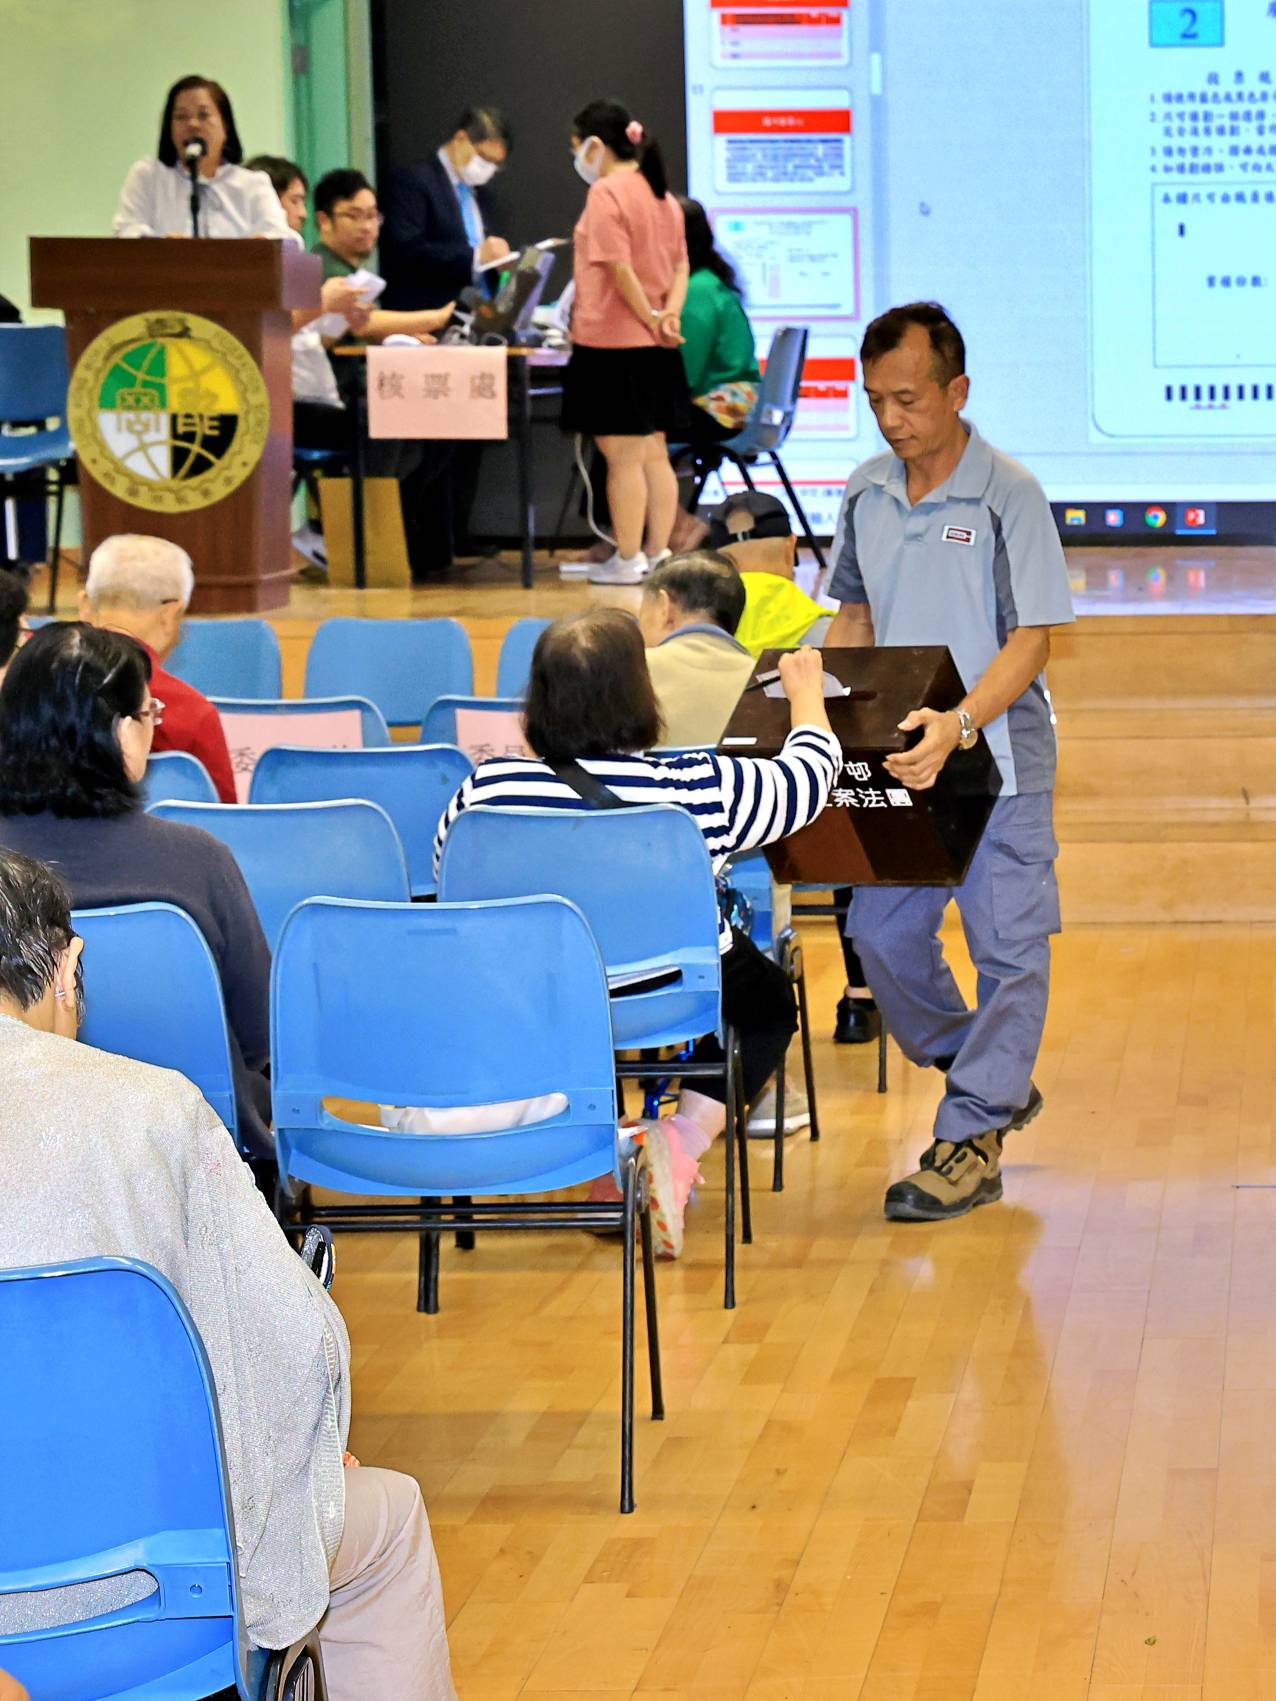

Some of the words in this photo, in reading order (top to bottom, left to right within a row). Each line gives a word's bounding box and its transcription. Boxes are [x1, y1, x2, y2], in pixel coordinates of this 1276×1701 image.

[1180, 7, 1199, 39] 2
[825, 787, 914, 808] 案法團
